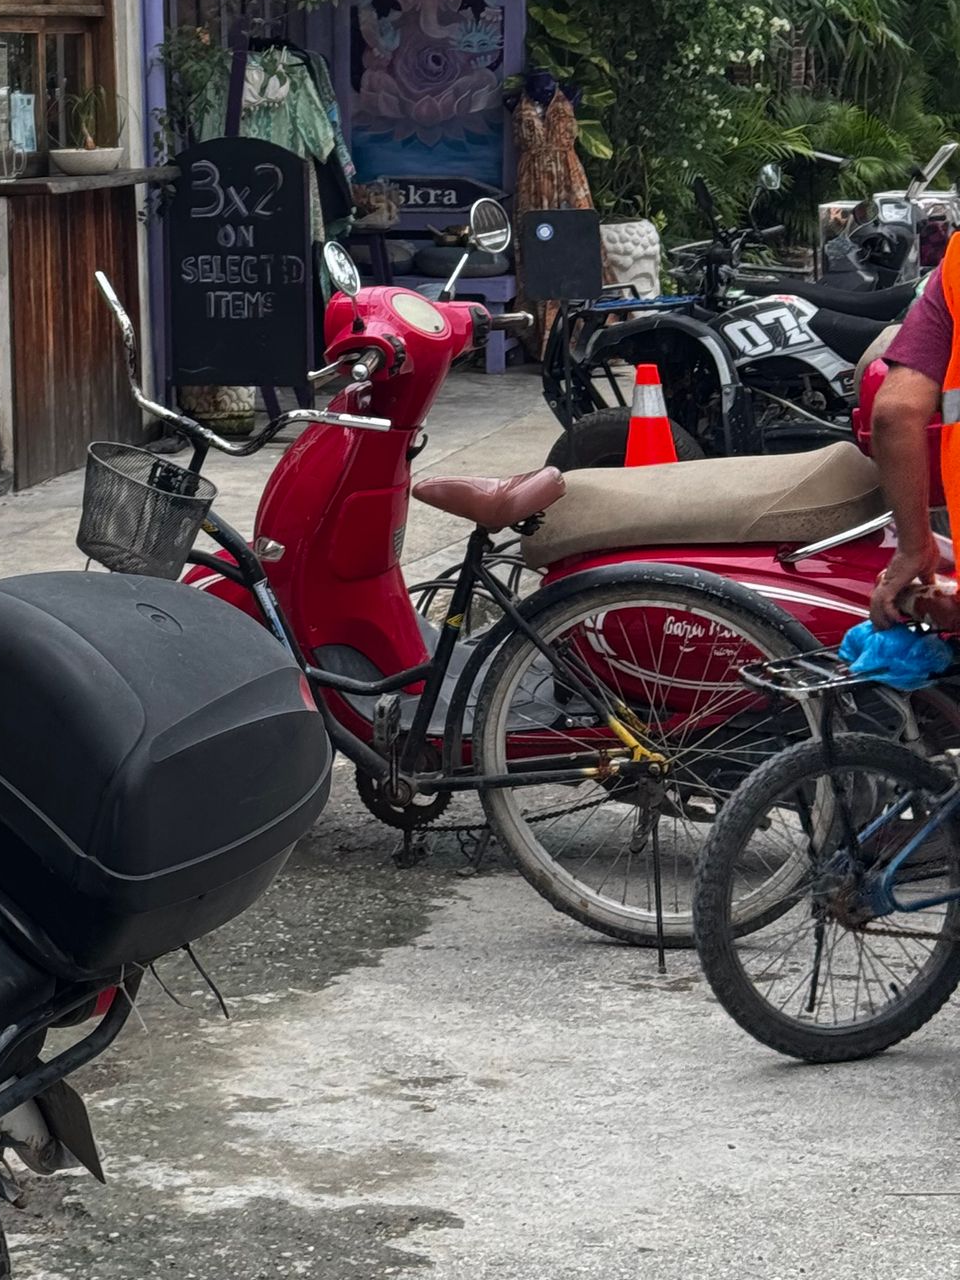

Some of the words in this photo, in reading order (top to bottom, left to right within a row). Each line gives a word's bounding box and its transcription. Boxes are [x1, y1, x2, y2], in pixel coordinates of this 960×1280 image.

[191, 159, 284, 219] 3x2
[399, 184, 458, 206] skra
[217, 223, 255, 248] ON
[206, 291, 276, 320] ITEMS
